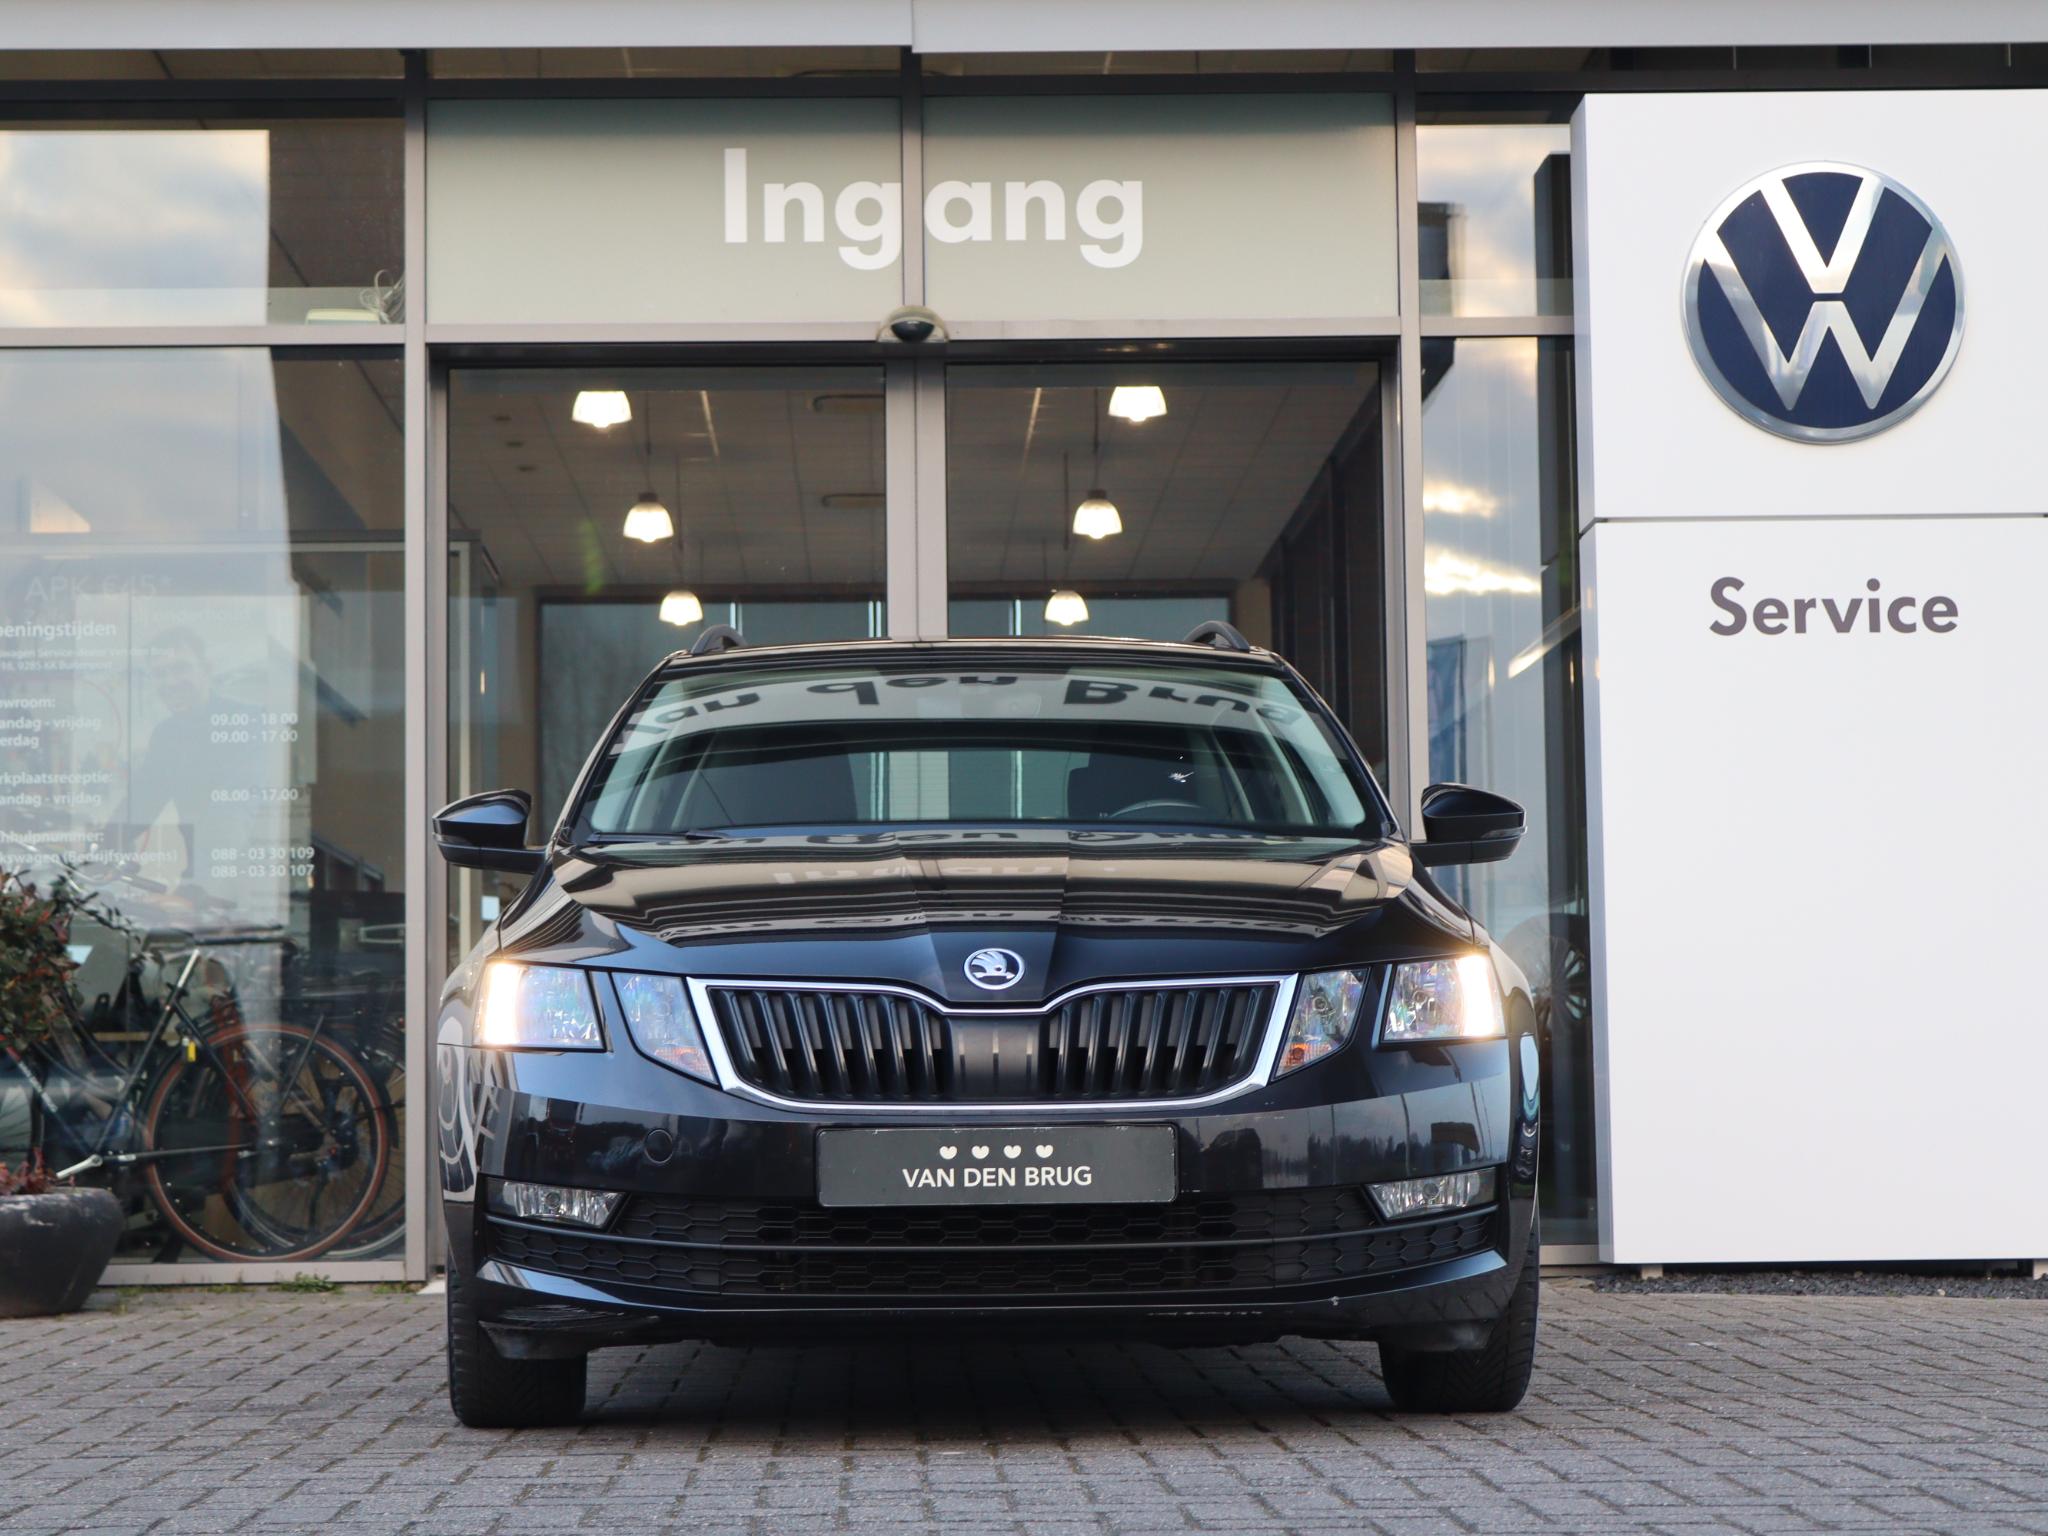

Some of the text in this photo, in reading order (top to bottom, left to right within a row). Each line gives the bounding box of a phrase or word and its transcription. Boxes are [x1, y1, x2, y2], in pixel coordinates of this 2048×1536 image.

[724, 147, 1144, 270] Ingang
[1690, 165, 1962, 420] VW
[1709, 576, 1959, 636] Service
[53, 716, 102, 732] vrijdag
[210, 713, 249, 726] 09.00
[210, 730, 249, 743] 09.00
[53, 792, 102, 808] vrijdag
[210, 789, 249, 802] 08.00
[261, 788, 298, 801] 17.00
[210, 847, 238, 861] 088
[290, 846, 315, 859] 109
[210, 864, 238, 878] 088
[290, 863, 315, 876] 107
[902, 1165, 1092, 1188] VAN DEN BRUG
